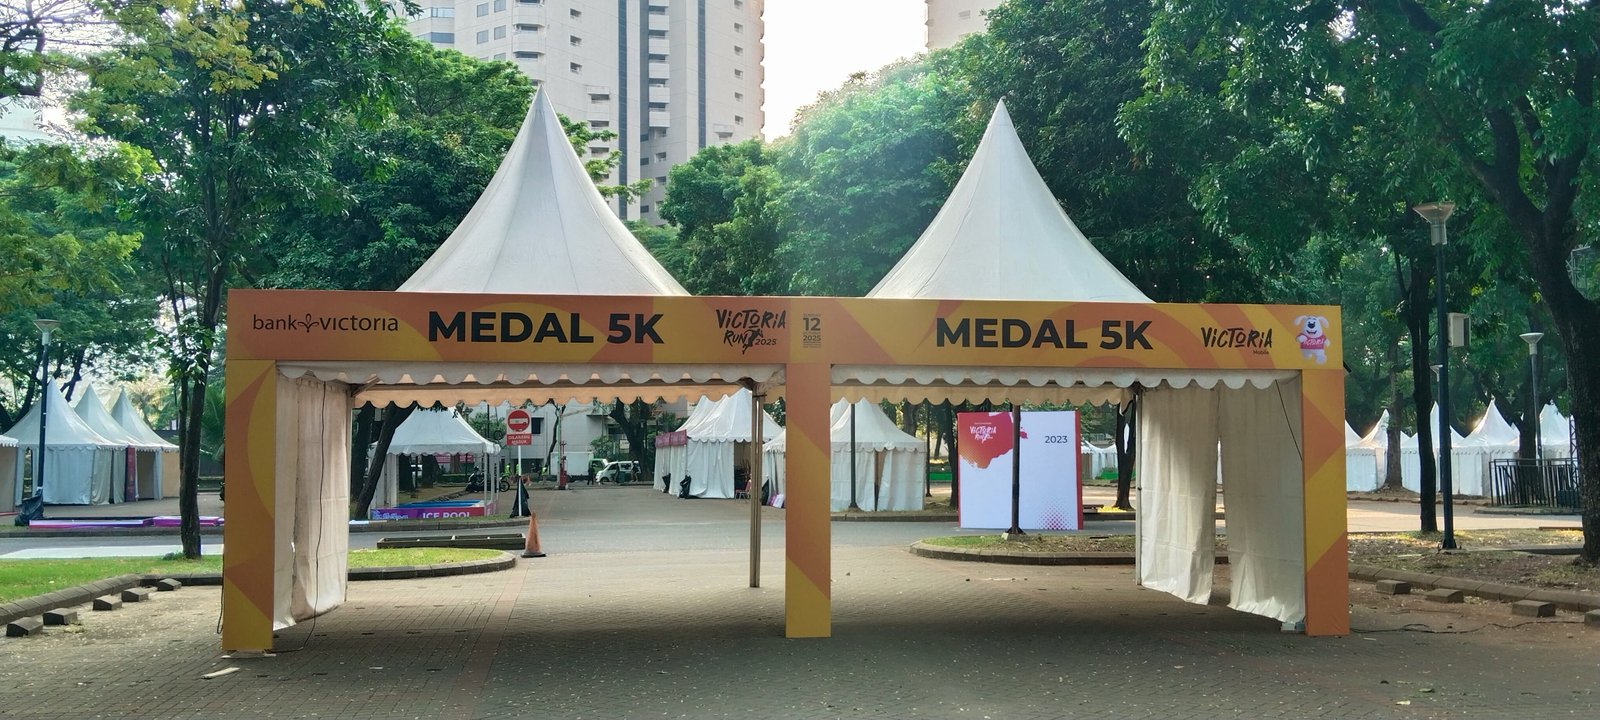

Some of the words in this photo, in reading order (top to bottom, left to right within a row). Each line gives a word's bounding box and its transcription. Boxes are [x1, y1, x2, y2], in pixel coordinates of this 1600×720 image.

[253, 314, 297, 331] bank
[428, 311, 594, 344] MEDAL
[606, 313, 665, 345] 5K
[803, 317, 821, 331] 12
[724, 330, 748, 347] RUN
[755, 338, 777, 346] 2025
[936, 317, 1088, 350] MEDAL
[1099, 319, 1153, 350] 5K
[1045, 435, 1068, 444] 2023
